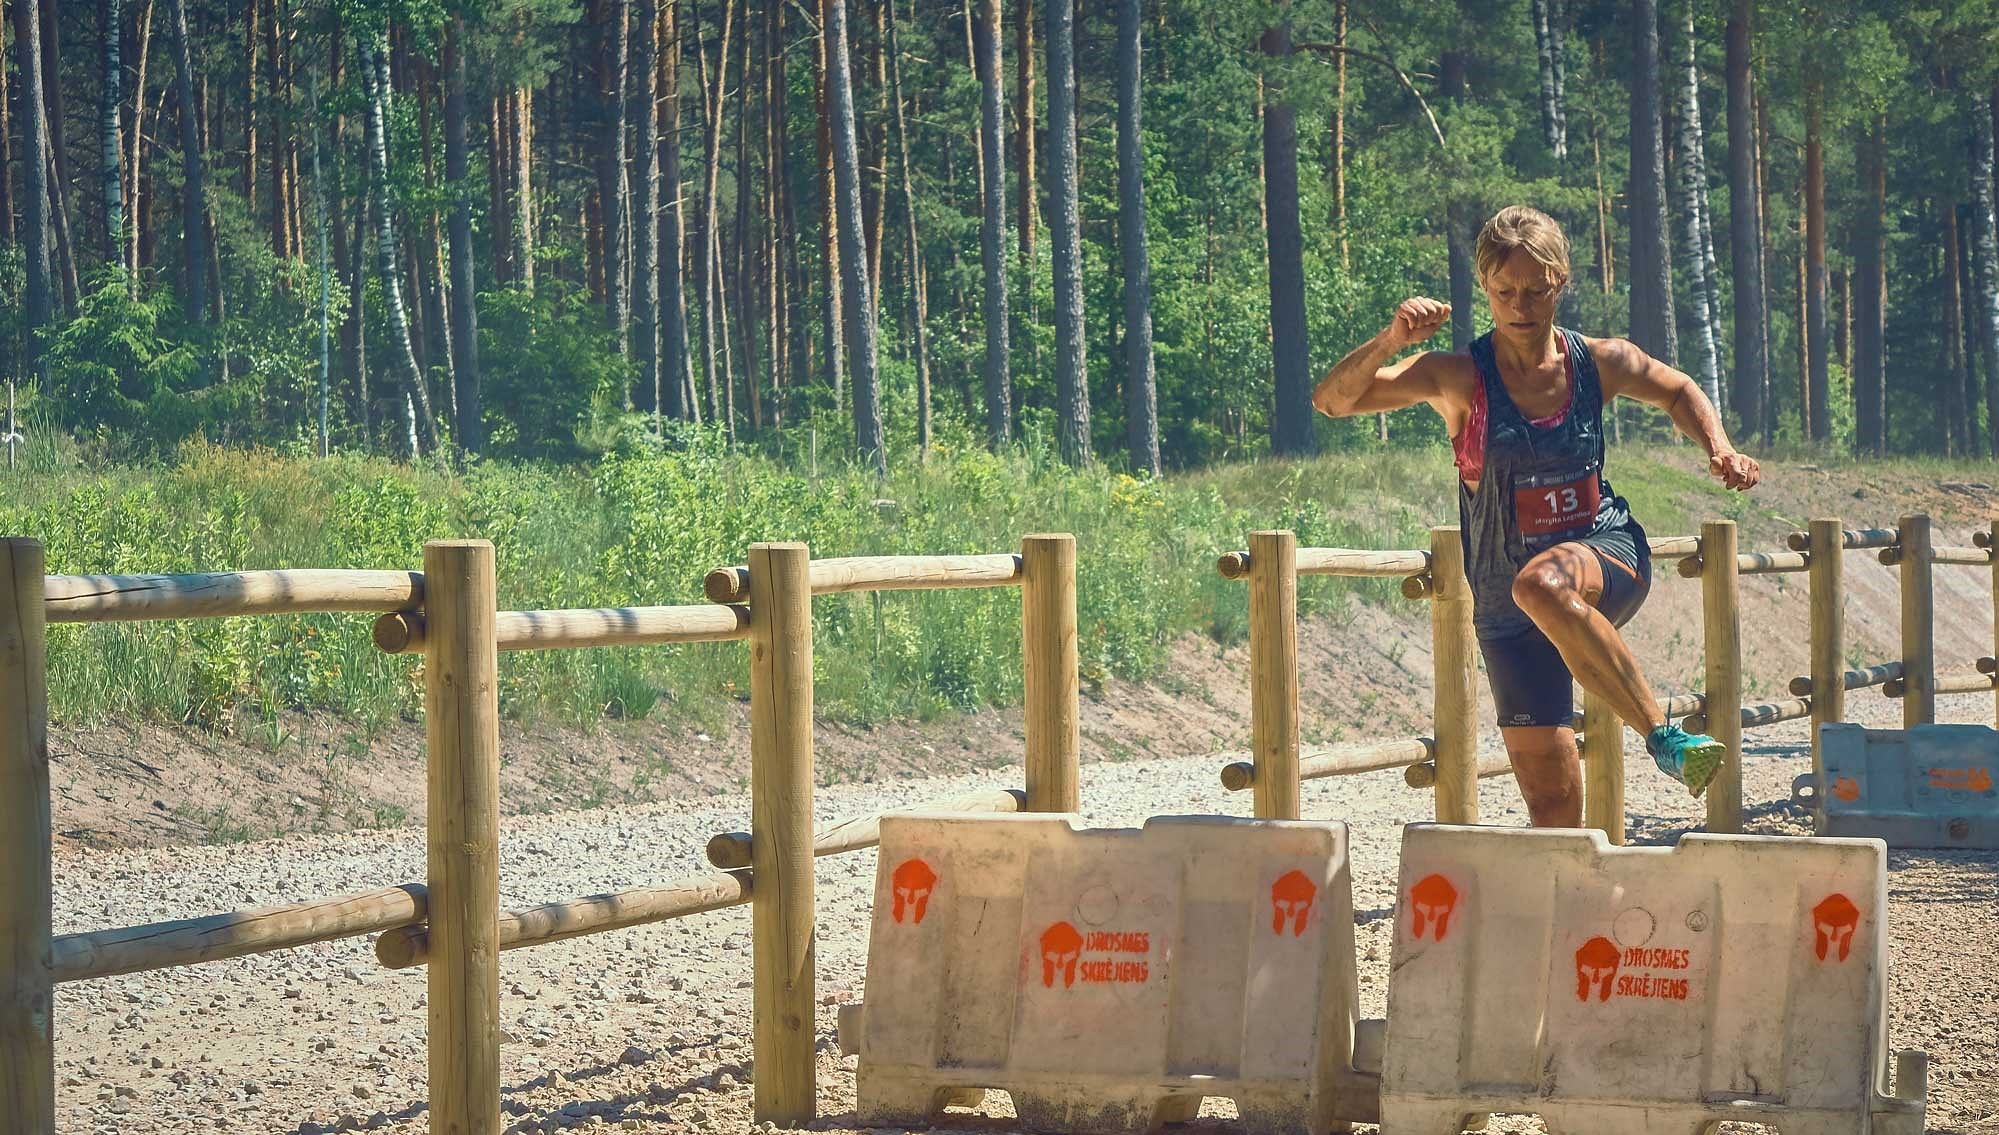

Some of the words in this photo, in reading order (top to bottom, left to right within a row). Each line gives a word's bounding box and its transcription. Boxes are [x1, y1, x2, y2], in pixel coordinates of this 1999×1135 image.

[1544, 487, 1578, 513] 13
[1086, 931, 1150, 953] DROSMES
[1623, 947, 1690, 970] DROSMES
